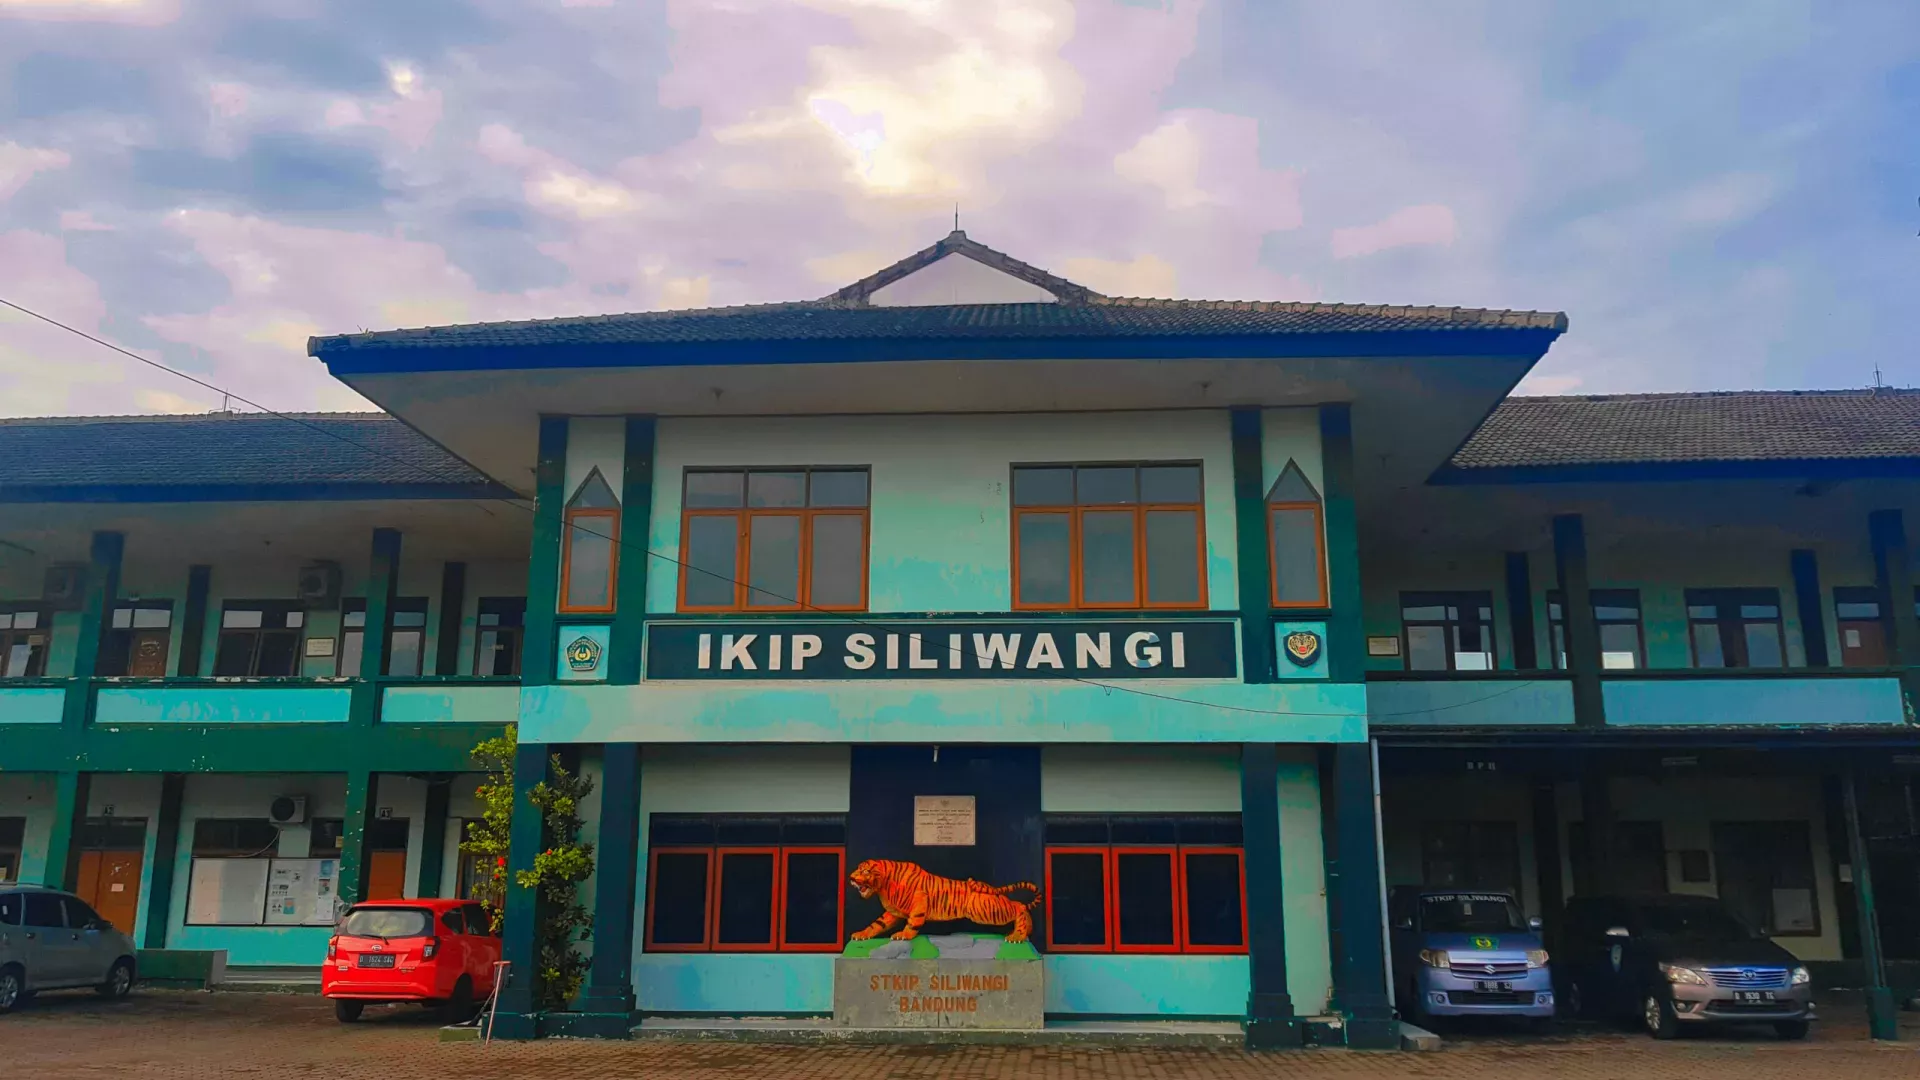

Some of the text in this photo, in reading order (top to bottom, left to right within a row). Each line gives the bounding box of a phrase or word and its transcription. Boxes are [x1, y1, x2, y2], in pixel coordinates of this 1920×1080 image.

[697, 631, 1185, 671] IKIP SILIWANGI
[1427, 895, 1455, 903] STKIP
[869, 974, 1010, 991] STKIP SILIWANGI
[900, 996, 978, 1013] BANDUNG
